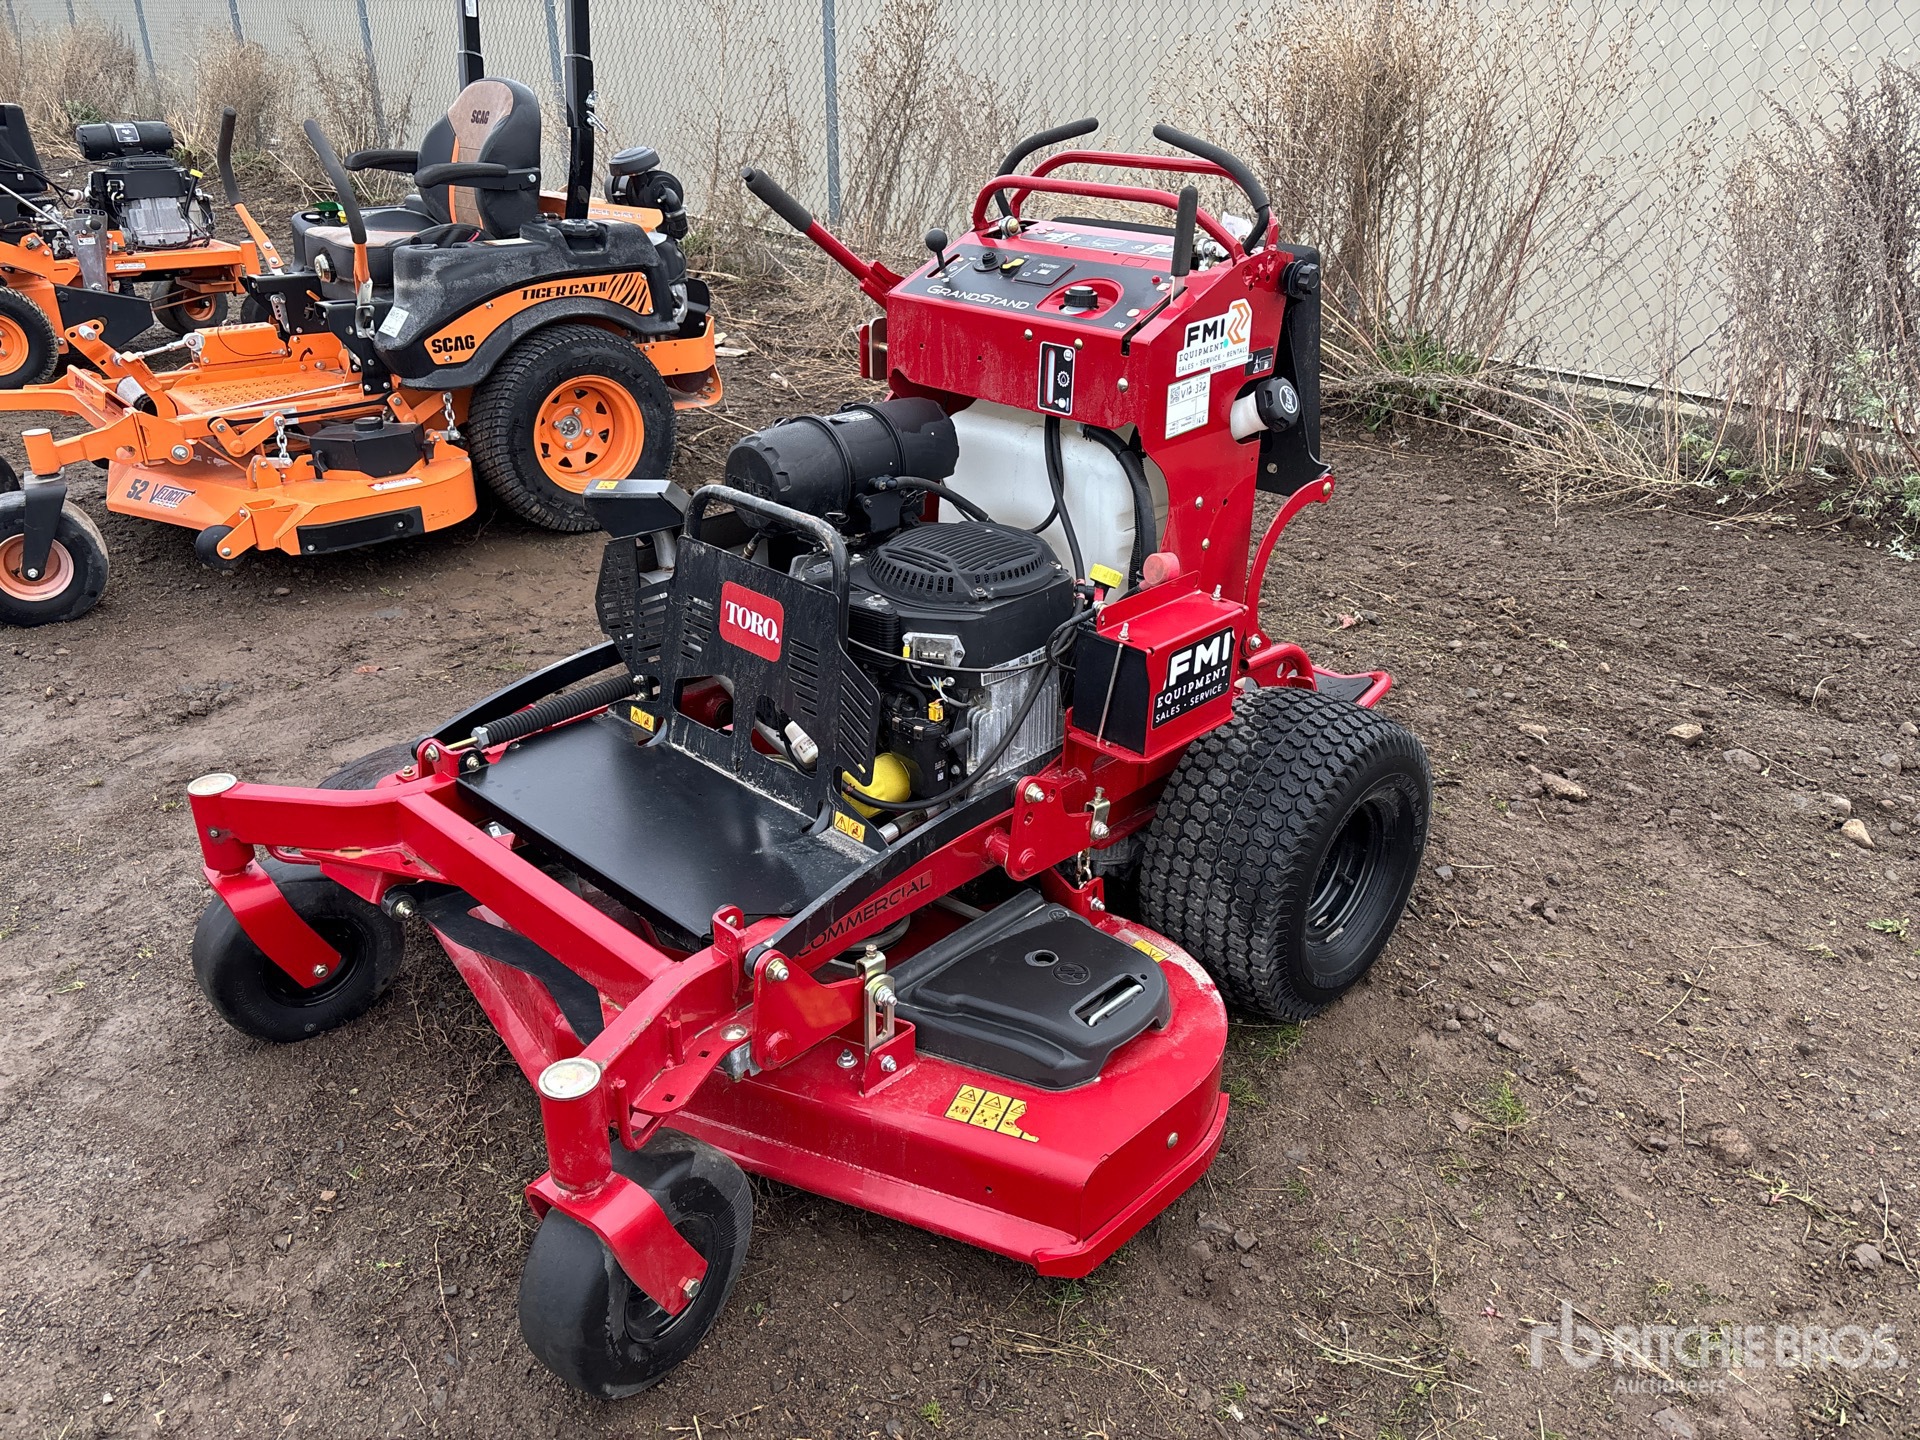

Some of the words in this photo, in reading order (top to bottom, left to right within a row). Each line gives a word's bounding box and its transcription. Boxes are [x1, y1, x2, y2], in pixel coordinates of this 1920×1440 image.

[471, 110, 490, 124] SCAG
[520, 285, 566, 300] TIGER
[568, 282, 598, 295] CAT
[599, 282, 608, 292] II
[431, 334, 476, 354] SCAG
[1186, 318, 1225, 348] FMI
[1178, 362, 1194, 373] SALES
[1200, 354, 1221, 366] SERVICE
[1227, 346, 1248, 358] RENTALS
[1179, 341, 1224, 362] EQUIPMENT
[126, 478, 150, 501] 52
[149, 483, 196, 503] VELOCITY
[1169, 631, 1231, 687] FMI
[1156, 665, 1228, 709] EQUIPMENT
[1155, 704, 1180, 724] SALES
[1189, 683, 1223, 707] SERVICE
